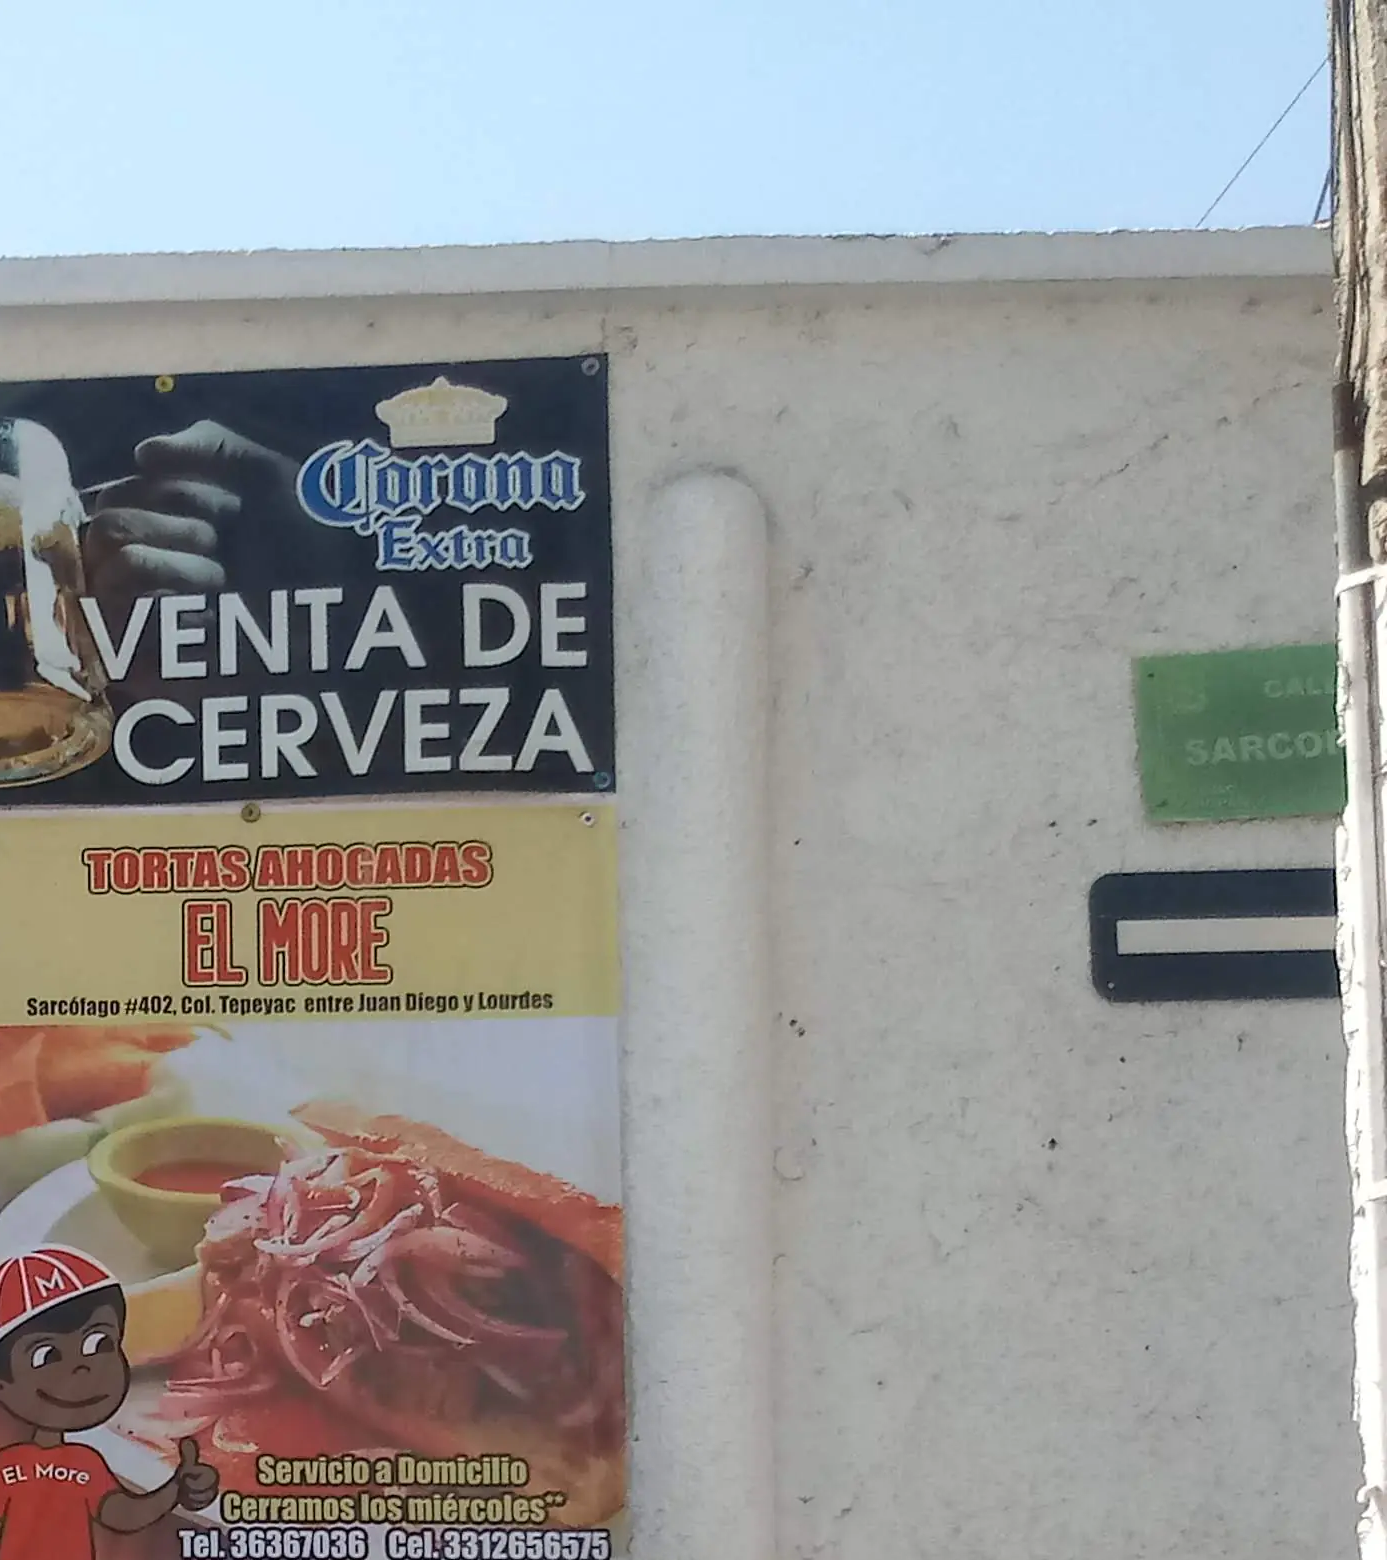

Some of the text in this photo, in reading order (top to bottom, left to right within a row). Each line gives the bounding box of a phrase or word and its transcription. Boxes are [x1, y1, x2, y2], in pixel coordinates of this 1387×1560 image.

[296, 438, 586, 536] Corona
[375, 515, 533, 571] Extra
[80, 583, 588, 679] VENTA DE
[1264, 678, 1334, 698] CAL
[113, 687, 594, 785] CERVEZA
[82, 841, 493, 893] TORTAS AHOGADAS
[182, 897, 393, 987] EL MORE
[181, 996, 216, 1014] Col.
[219, 996, 295, 1016] Tepeyac
[304, 995, 354, 1013] entre
[357, 993, 402, 1012] Juan
[405, 991, 459, 1013] Diego
[463, 993, 475, 1012] y
[478, 990, 554, 1011] Lourdes
[34, 1267, 65, 1298] M
[2, 1462, 90, 1485] EL More
[256, 1455, 528, 1487] Servicio a Domicilio
[220, 1493, 355, 1525] Cerramos
[359, 1493, 403, 1525] los
[178, 1529, 225, 1560] Tel.
